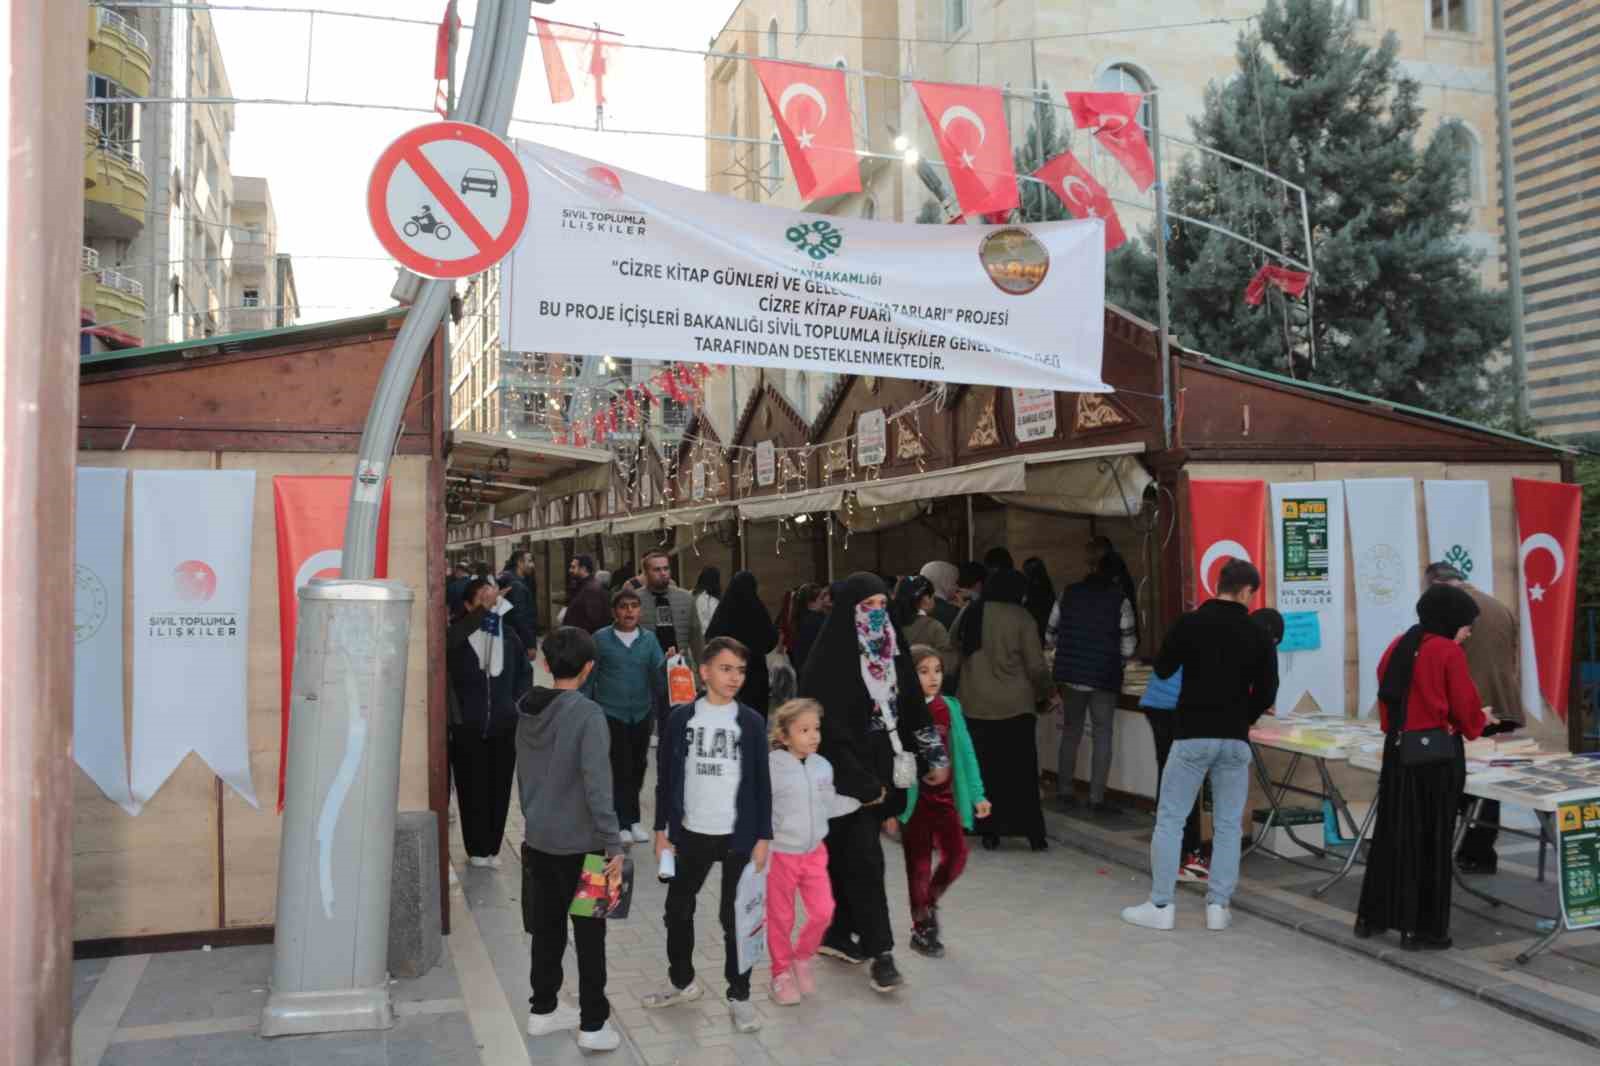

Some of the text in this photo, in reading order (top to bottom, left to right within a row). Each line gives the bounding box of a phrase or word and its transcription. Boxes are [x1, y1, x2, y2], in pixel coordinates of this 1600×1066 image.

[562, 220, 646, 235] İLİŞKİLER
[590, 211, 646, 225] TOPLUMLA
[666, 262, 709, 283] KİTAP
[713, 267, 779, 290] GÜNLERİ
[782, 276, 801, 292] VE
[956, 308, 1009, 326] PROJESİ
[759, 293, 801, 315] CİZRE
[804, 298, 847, 319] KİTAP
[539, 300, 992, 353] BU PROJE İÇİŞLERİ BAKANLIĞI SİVİL TOPLUMLA İLİŞKİLER GENEL
[694, 335, 945, 371] TARAFINDAN DESTEKLENMEKTEDİR.
[179, 616, 237, 626] TOPLUMLA
[149, 626, 237, 637] İLİŞKİLER
